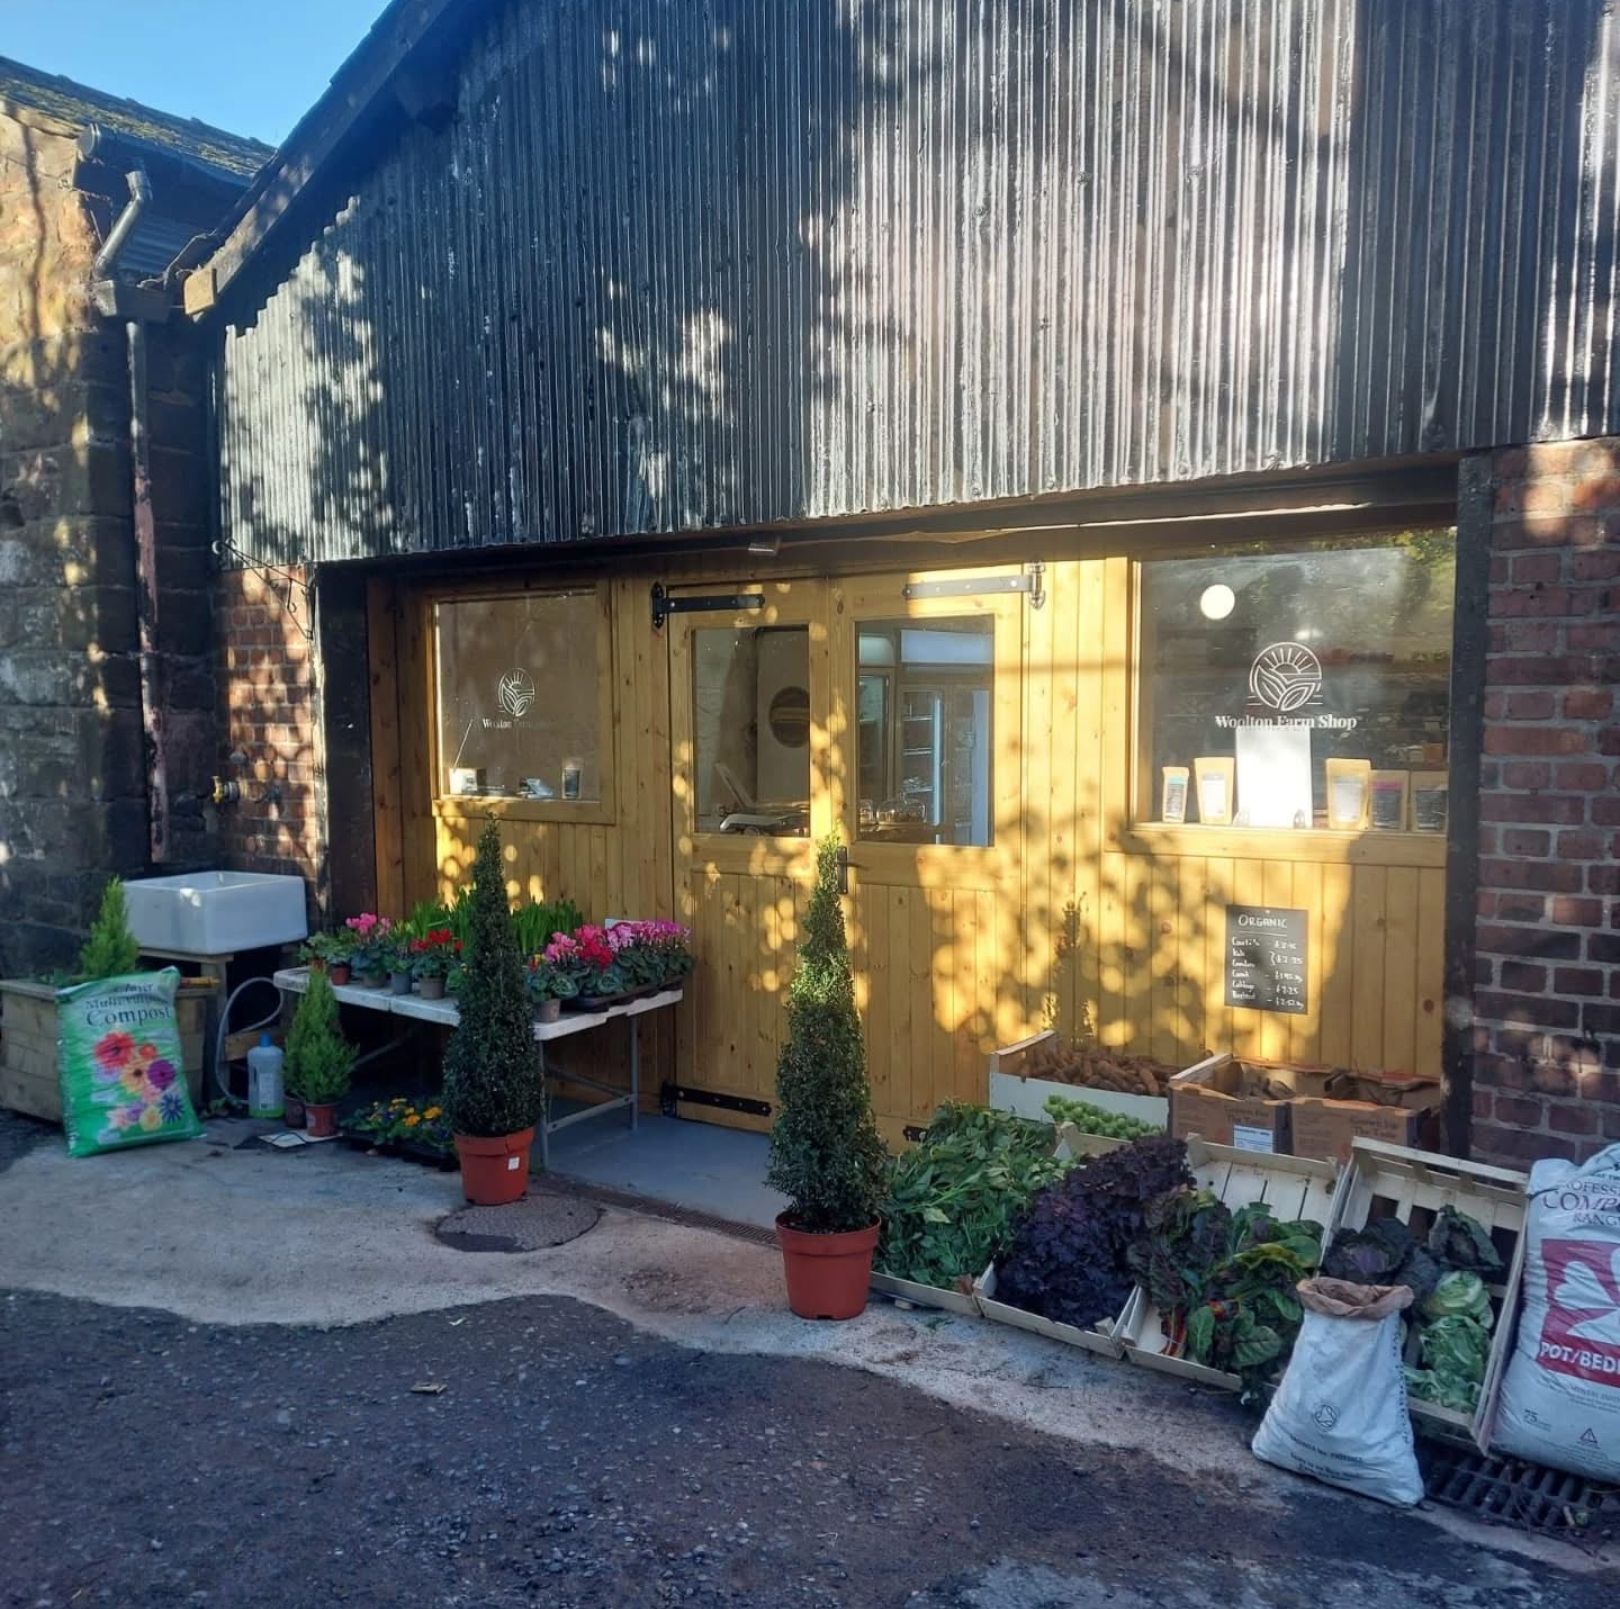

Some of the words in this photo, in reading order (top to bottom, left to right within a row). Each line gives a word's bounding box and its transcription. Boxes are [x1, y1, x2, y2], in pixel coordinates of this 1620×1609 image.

[1215, 714, 1273, 728] Woolton
[1277, 714, 1315, 728] Farm
[1318, 713, 1358, 730] Shop
[86, 1007, 172, 1027] Compost
[1543, 1191, 1620, 1211] COMP
[1573, 1212, 1620, 1226] RANG
